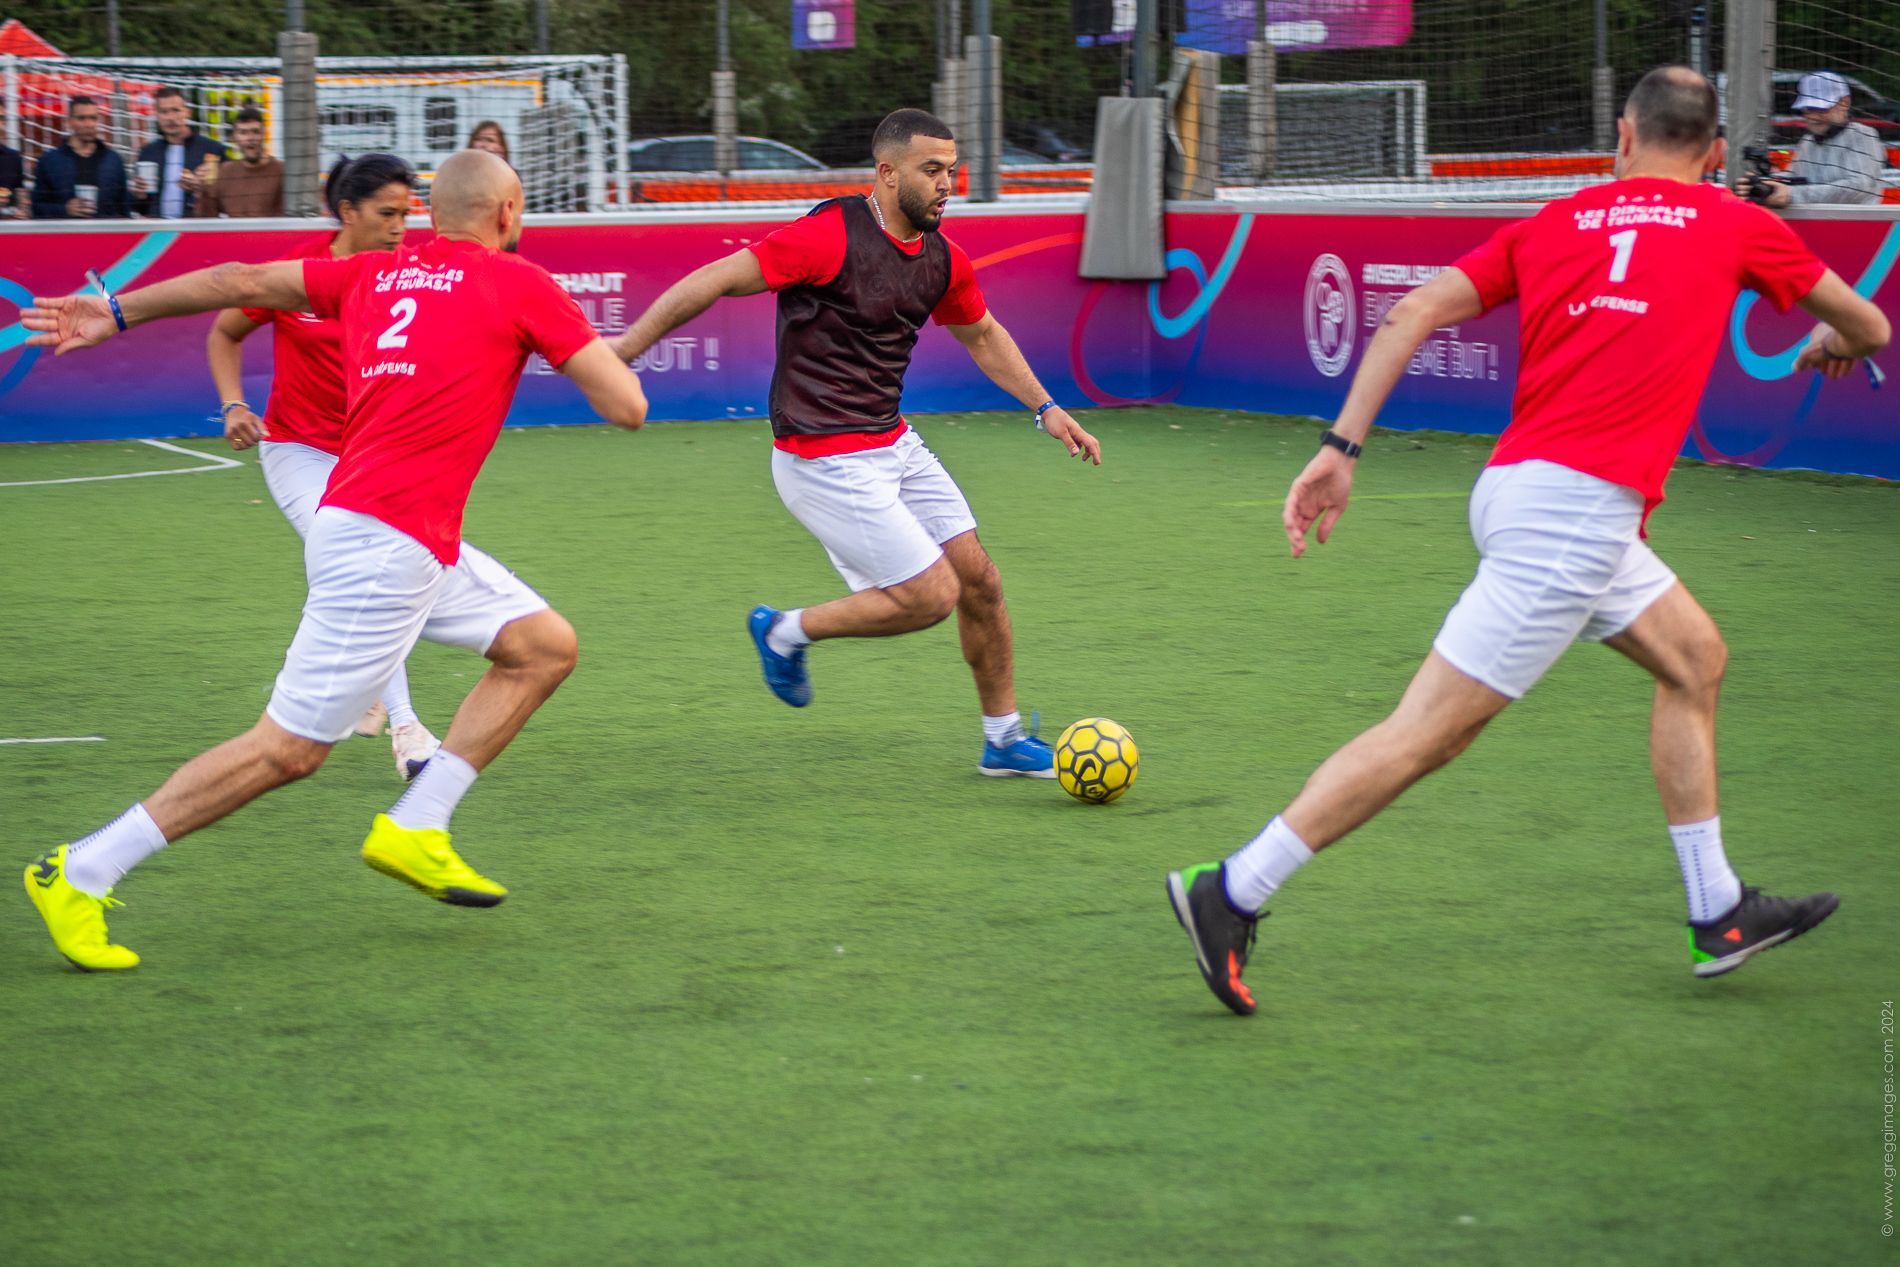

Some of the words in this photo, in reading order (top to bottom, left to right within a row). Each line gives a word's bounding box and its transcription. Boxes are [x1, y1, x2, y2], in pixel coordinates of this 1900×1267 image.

[1574, 209, 1605, 220] LES
[1609, 205, 1697, 219] DISCIPLES
[1577, 218, 1602, 230] DE
[1607, 213, 1686, 228] TSUBASA
[1609, 229, 1638, 282] 1
[375, 280, 393, 292] DE
[395, 278, 452, 293] TSUBASA
[1568, 302, 1587, 316] LA
[377, 297, 417, 349] 2
[361, 366, 373, 378] LA
